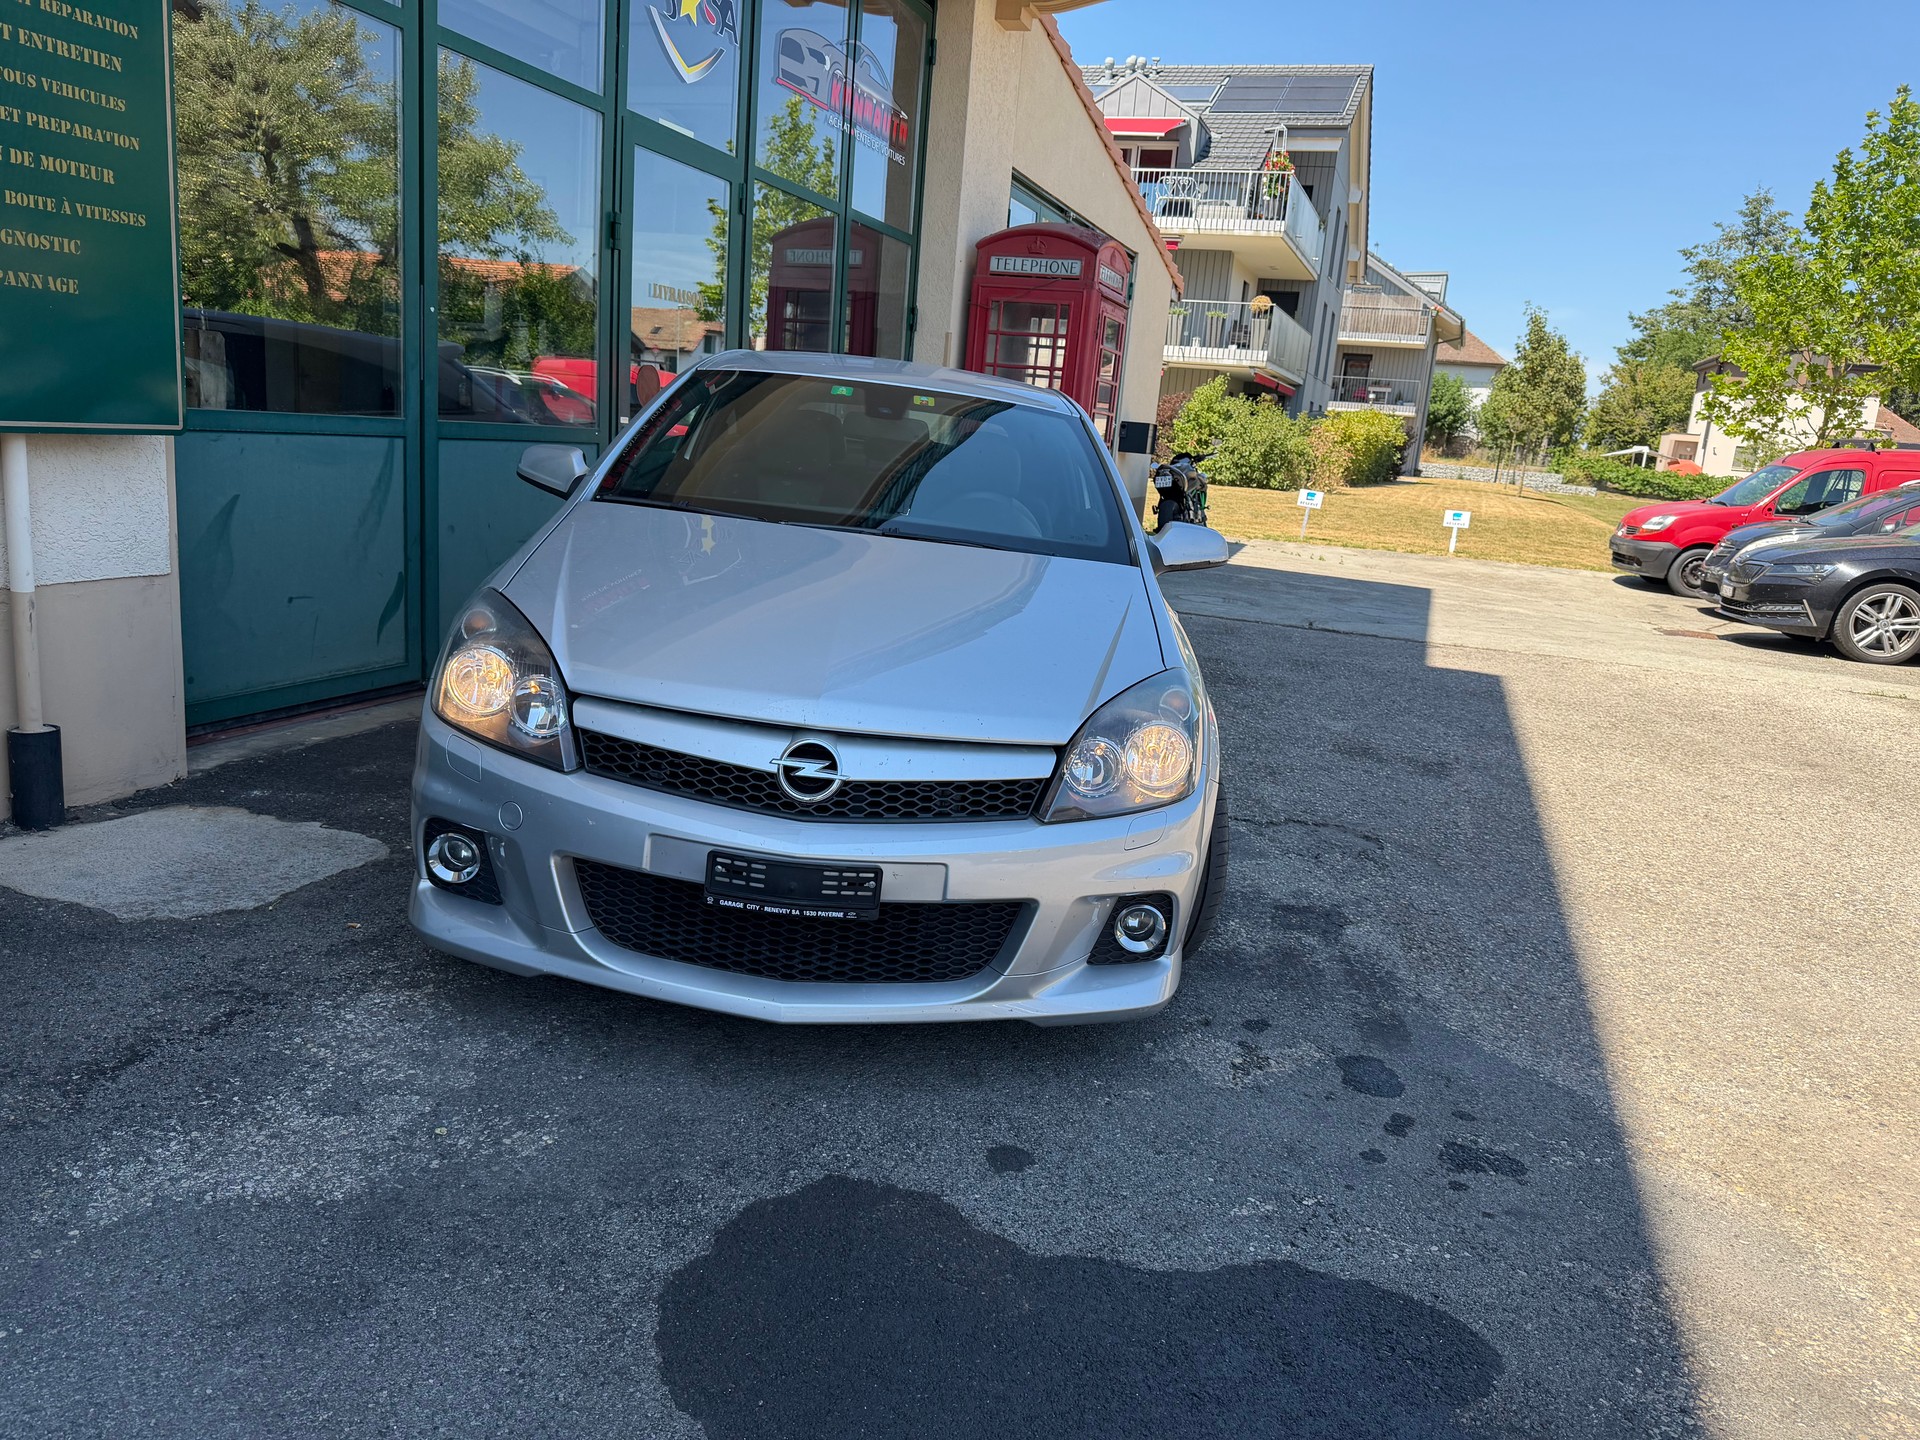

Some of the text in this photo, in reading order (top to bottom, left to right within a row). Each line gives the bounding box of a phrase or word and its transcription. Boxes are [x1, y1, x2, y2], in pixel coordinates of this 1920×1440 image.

[39, 0, 139, 39] REPARATION
[18, 28, 122, 73] ENTRETIEN
[0, 65, 126, 112] OUS VEHICULES
[0, 104, 140, 151] ET PREPARATION
[828, 115, 850, 135] ACHAT
[880, 144, 906, 166] VOITURES
[9, 147, 35, 168] DE
[40, 154, 115, 185] MOTEUR
[4, 189, 147, 227] BOITE À VITESSES
[0, 228, 81, 255] GNOSTIC
[995, 257, 1078, 275] TELEPHONE
[719, 899, 744, 909] GARAGE
[746, 903, 760, 911] CITY
[764, 906, 791, 915] RENEVEY
[817, 911, 844, 919] PAYERNE
